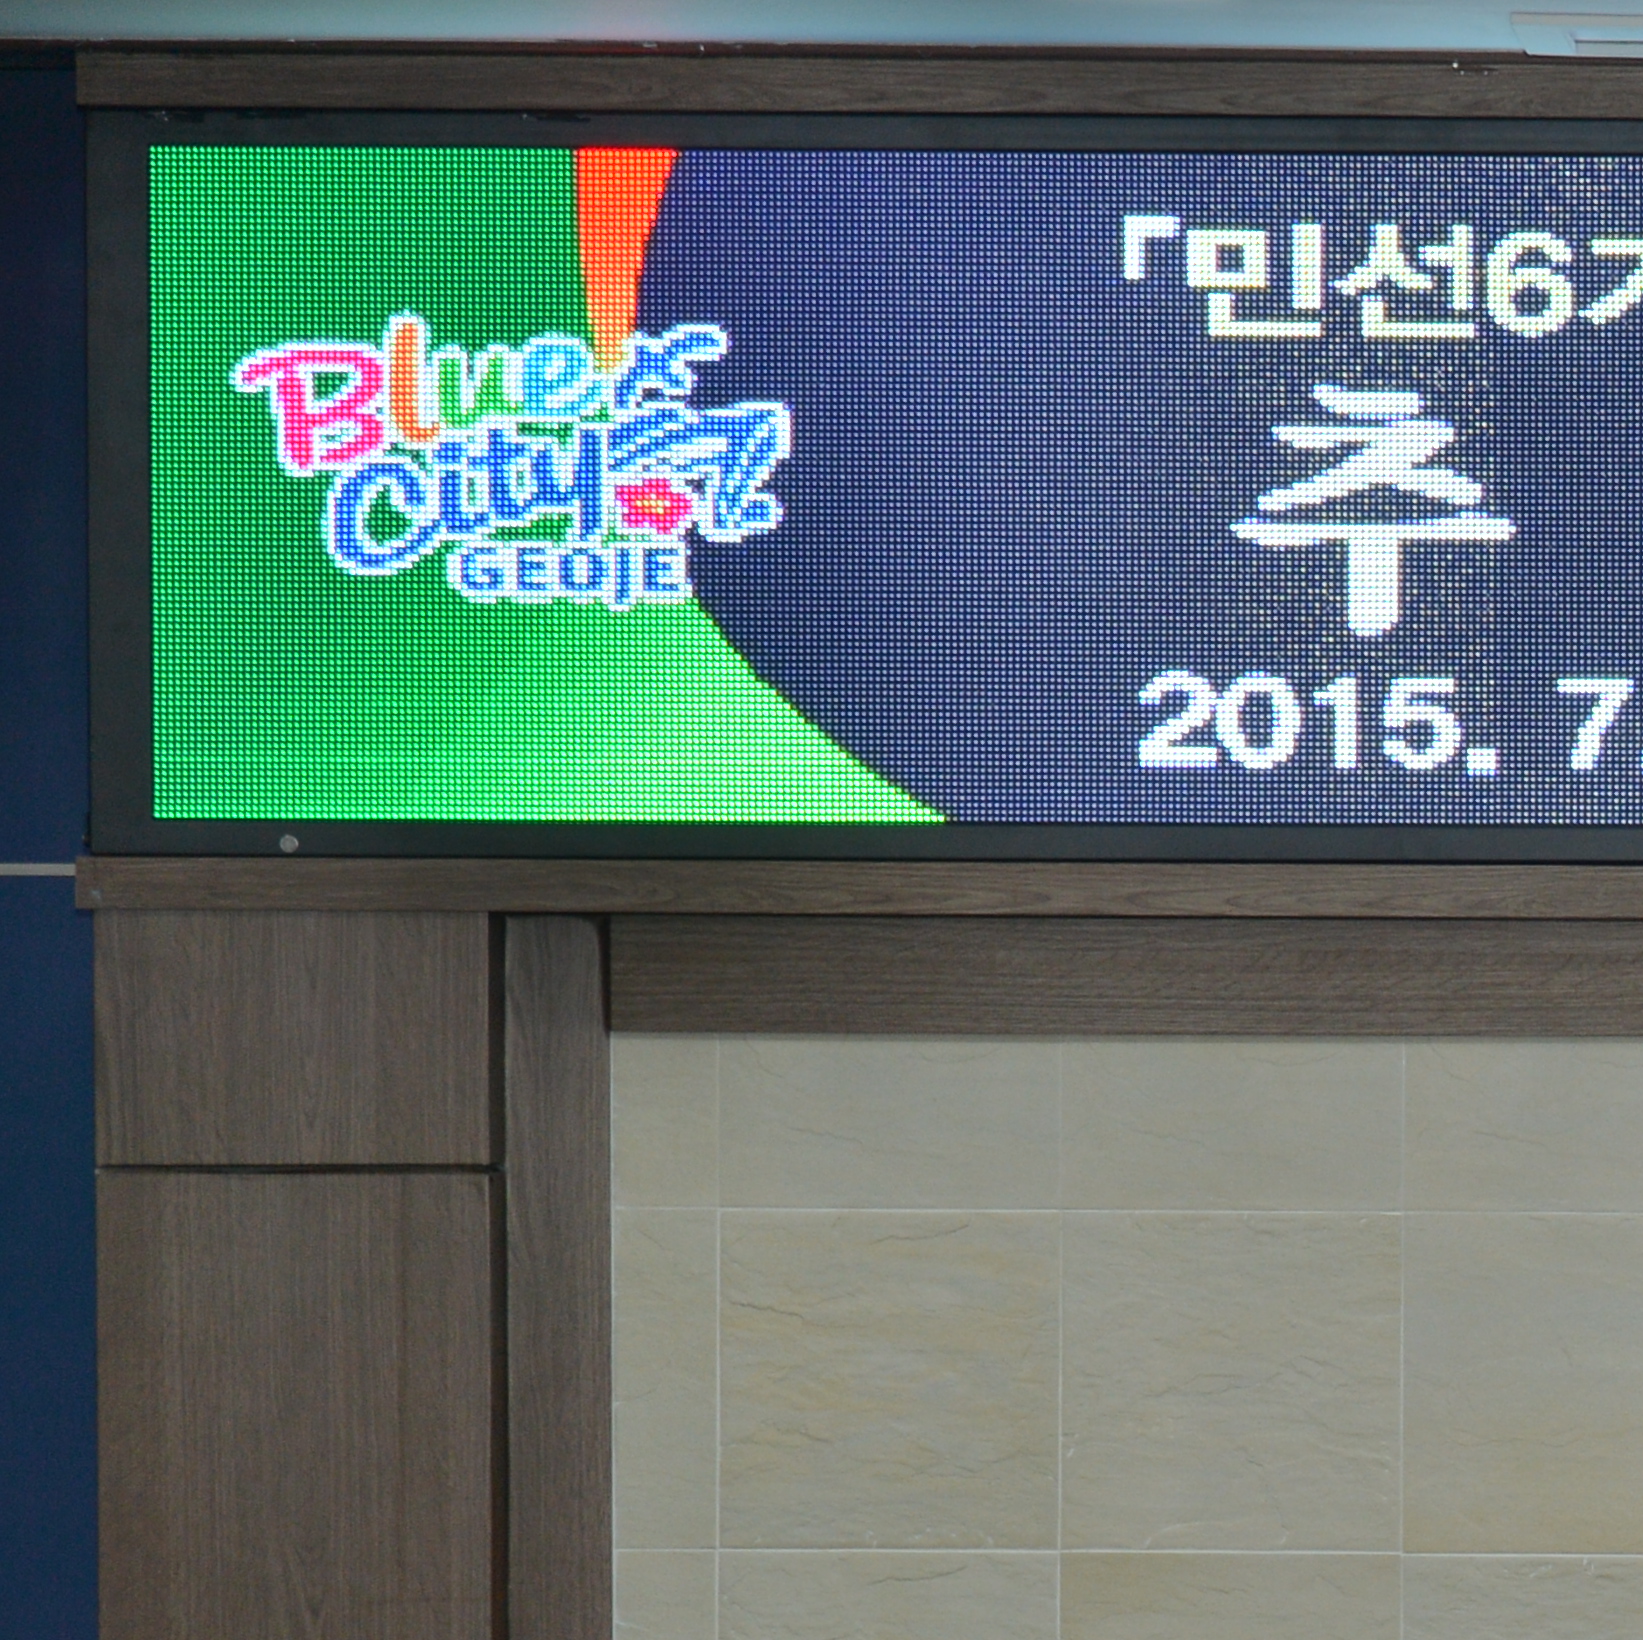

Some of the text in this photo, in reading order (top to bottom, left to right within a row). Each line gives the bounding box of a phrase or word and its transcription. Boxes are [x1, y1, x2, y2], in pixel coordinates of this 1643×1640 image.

[232, 310, 607, 474] Blue
[326, 418, 603, 575] City
[448, 536, 694, 607] GEOJE
[1137, 669, 1499, 776] 2015.
